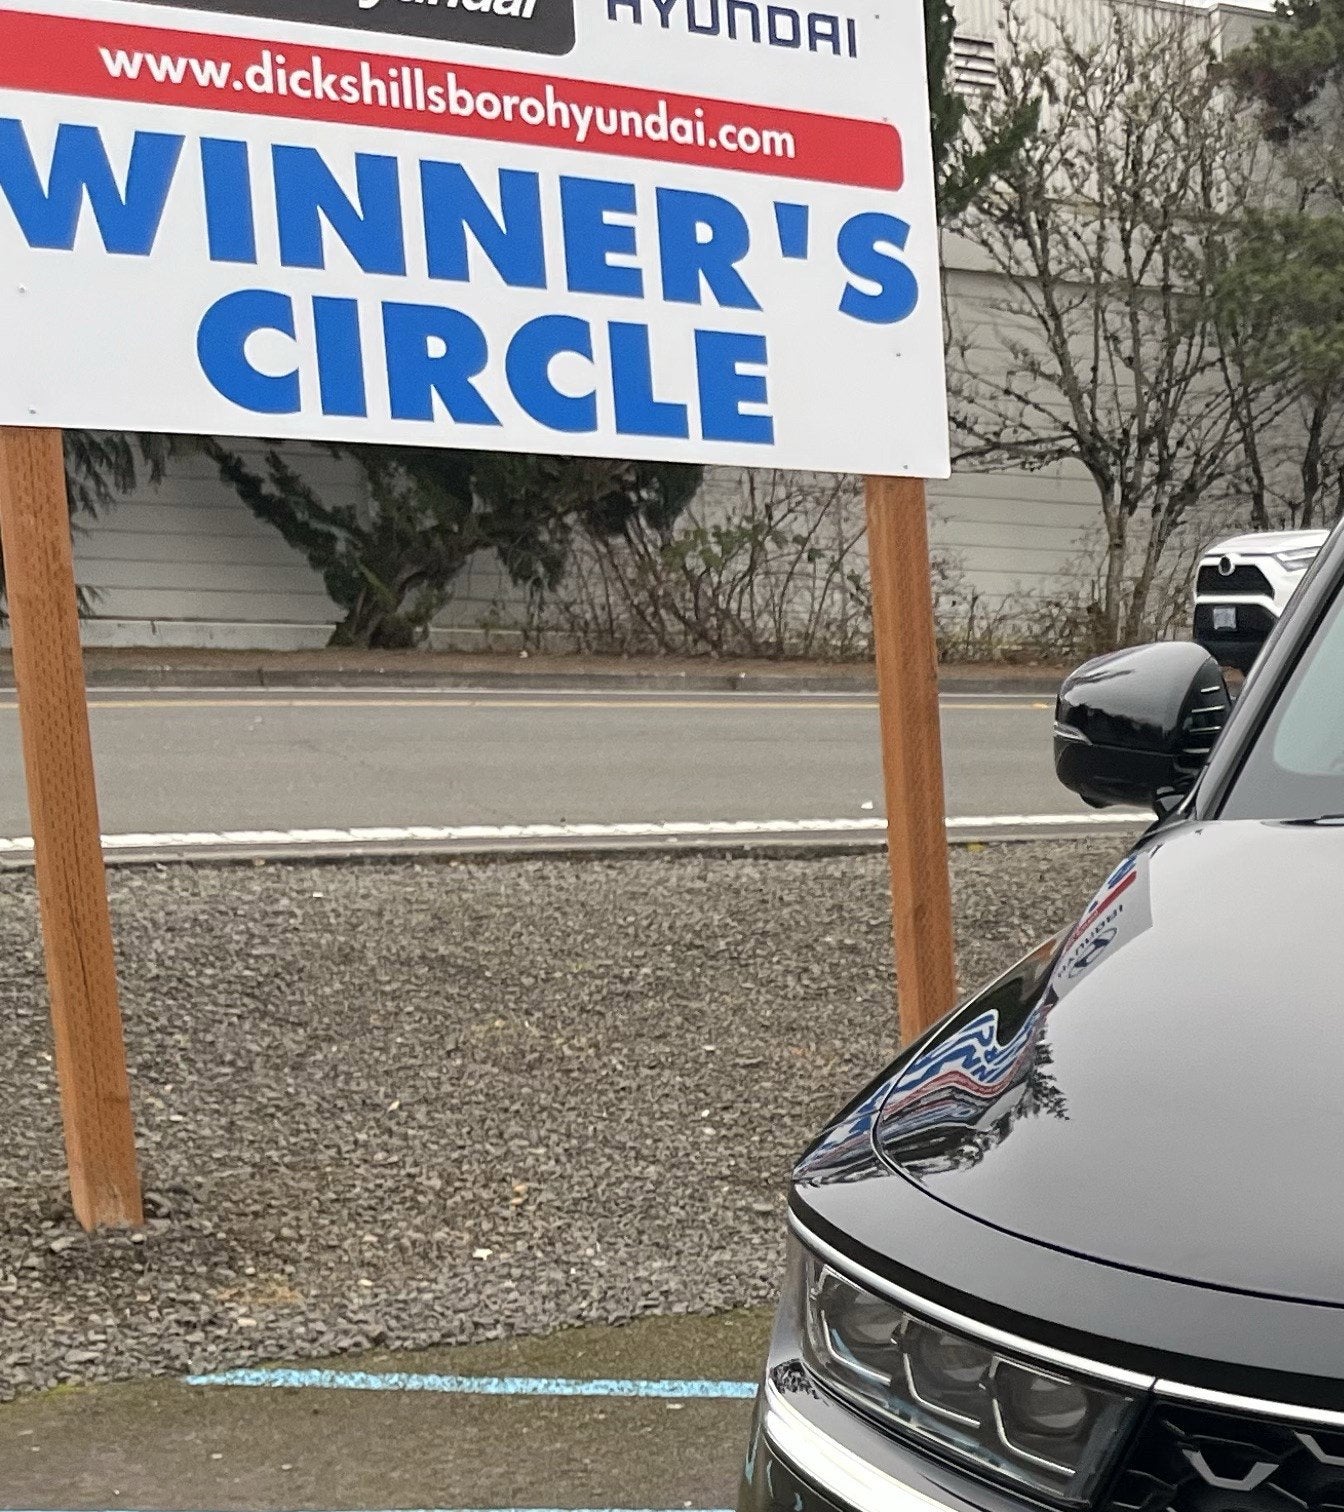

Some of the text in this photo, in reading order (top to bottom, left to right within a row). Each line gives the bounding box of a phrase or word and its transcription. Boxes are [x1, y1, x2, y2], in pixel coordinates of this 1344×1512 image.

[98, 47, 796, 159] www.dickshillsborohyundai.com
[0, 116, 918, 324] WINNER'S
[197, 288, 774, 445] CIRCLE
